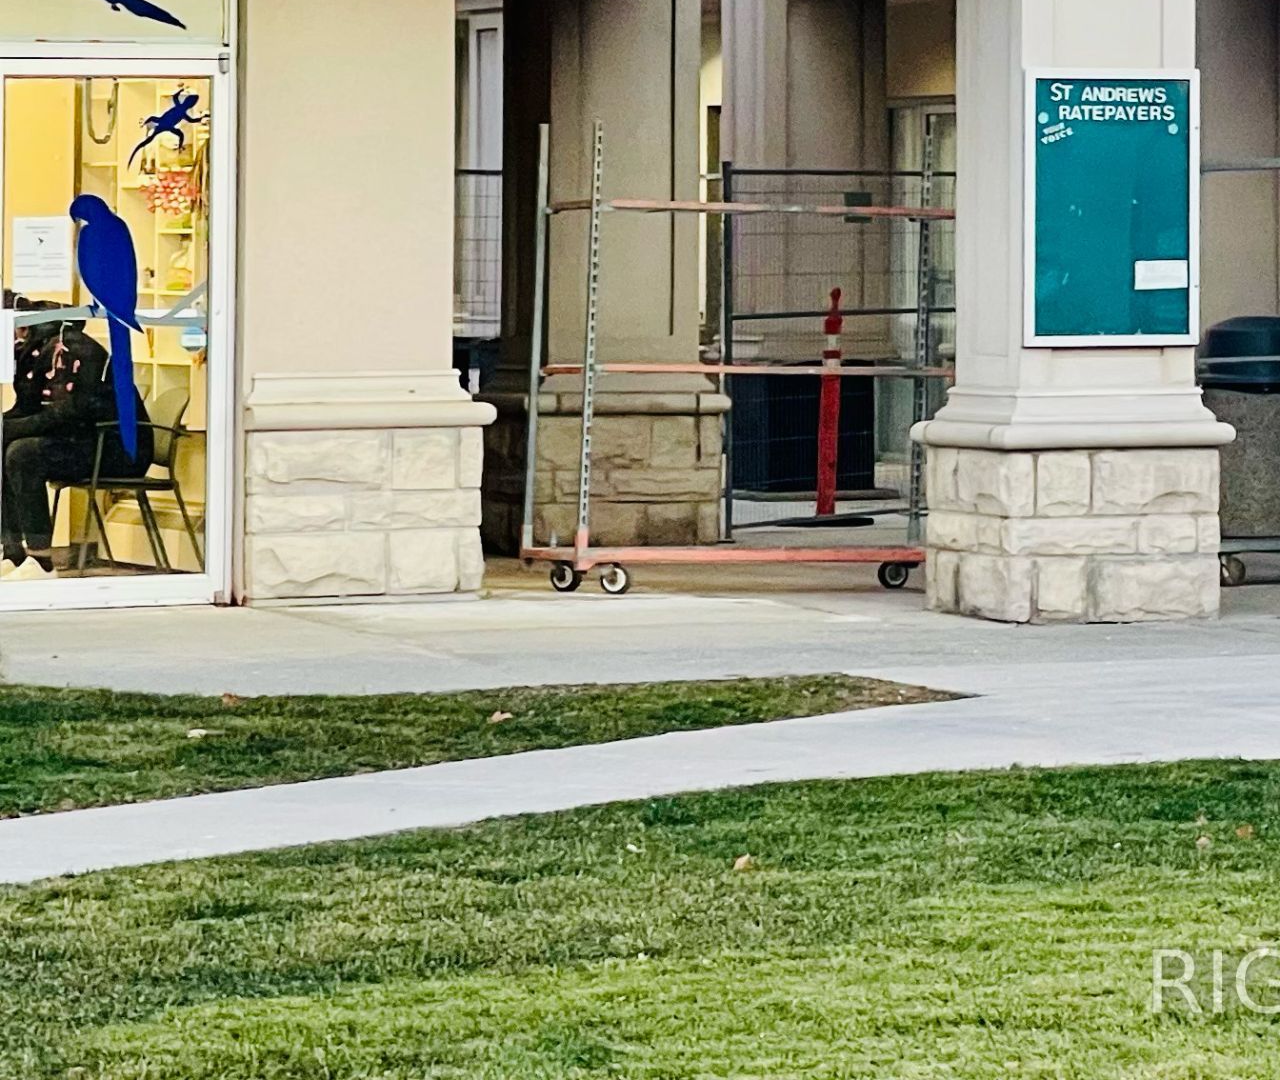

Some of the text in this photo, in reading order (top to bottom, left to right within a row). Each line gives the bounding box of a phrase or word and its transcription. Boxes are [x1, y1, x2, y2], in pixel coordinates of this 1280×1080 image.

[1050, 83, 1167, 104] ST ANDREWS
[1058, 104, 1176, 121] RATEPAYERS
